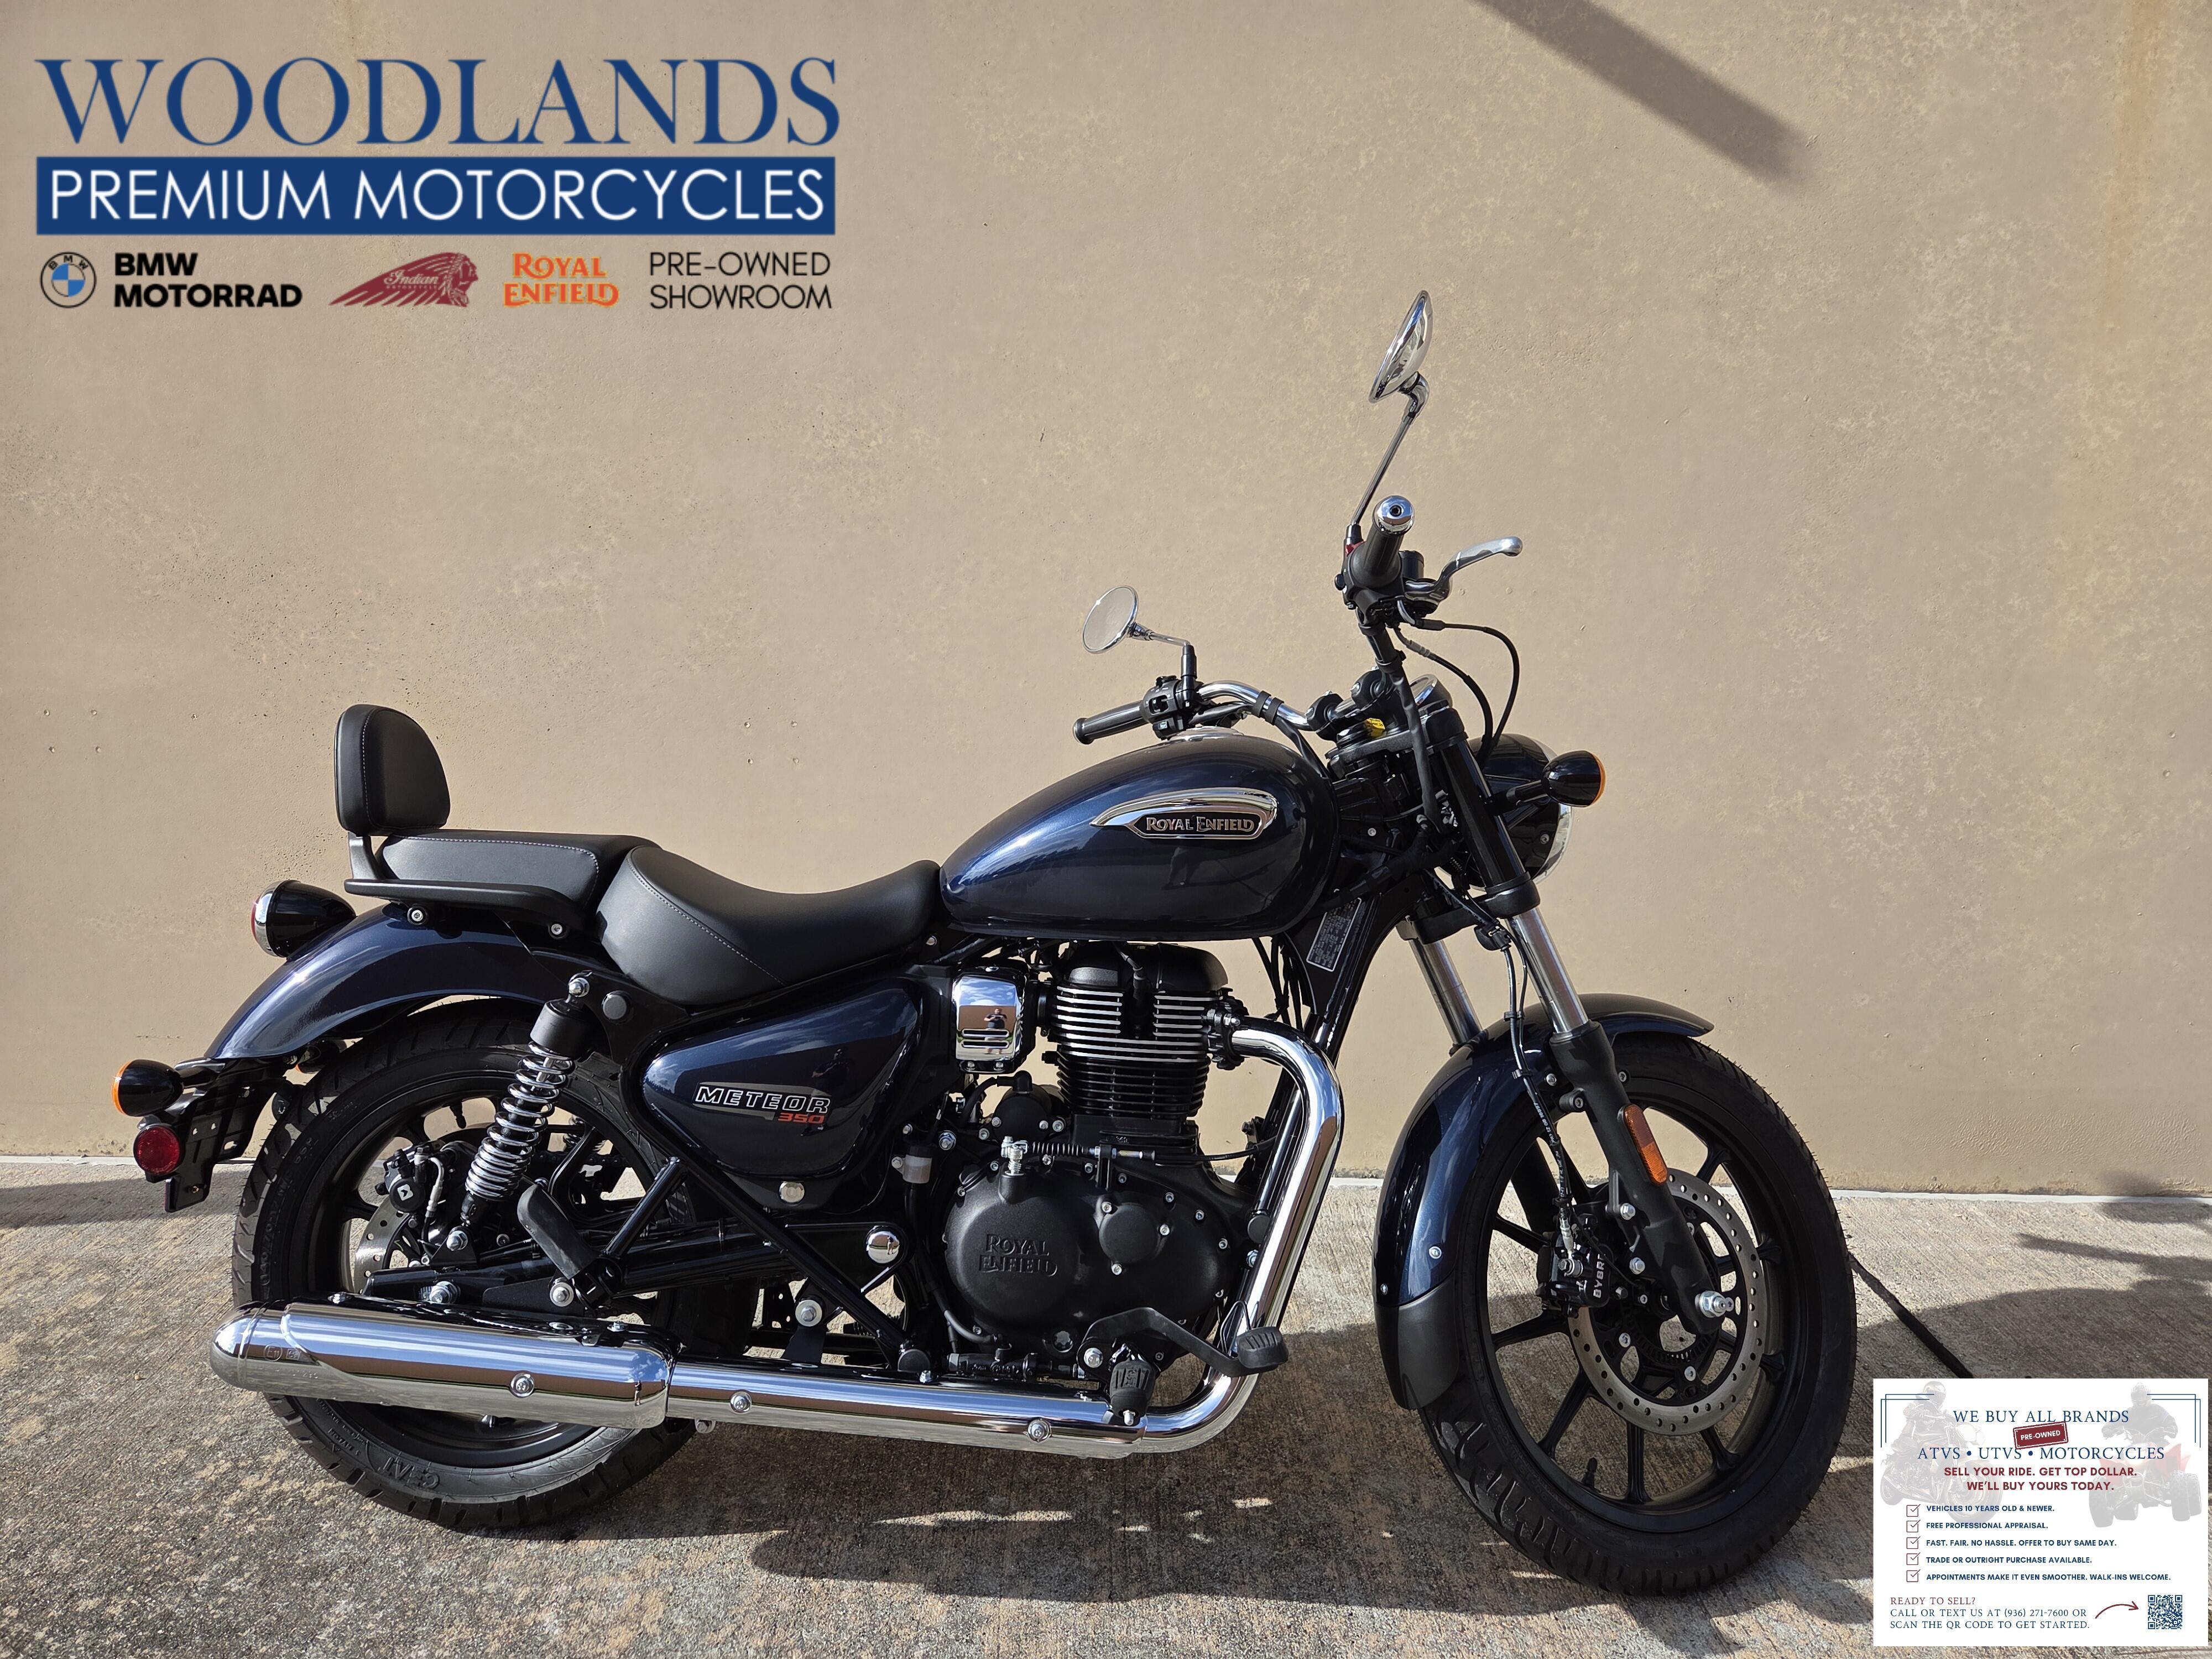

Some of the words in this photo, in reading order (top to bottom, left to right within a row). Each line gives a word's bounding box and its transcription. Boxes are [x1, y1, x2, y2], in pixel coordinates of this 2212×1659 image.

[1146, 817, 1194, 831] ROYAL
[1196, 816, 1255, 832] ENFIELD
[695, 1086, 831, 1114] METEOR
[778, 1112, 825, 1124] 350
[986, 1233, 1050, 1256] ROYAL
[979, 1254, 1058, 1277] ENFIELD
